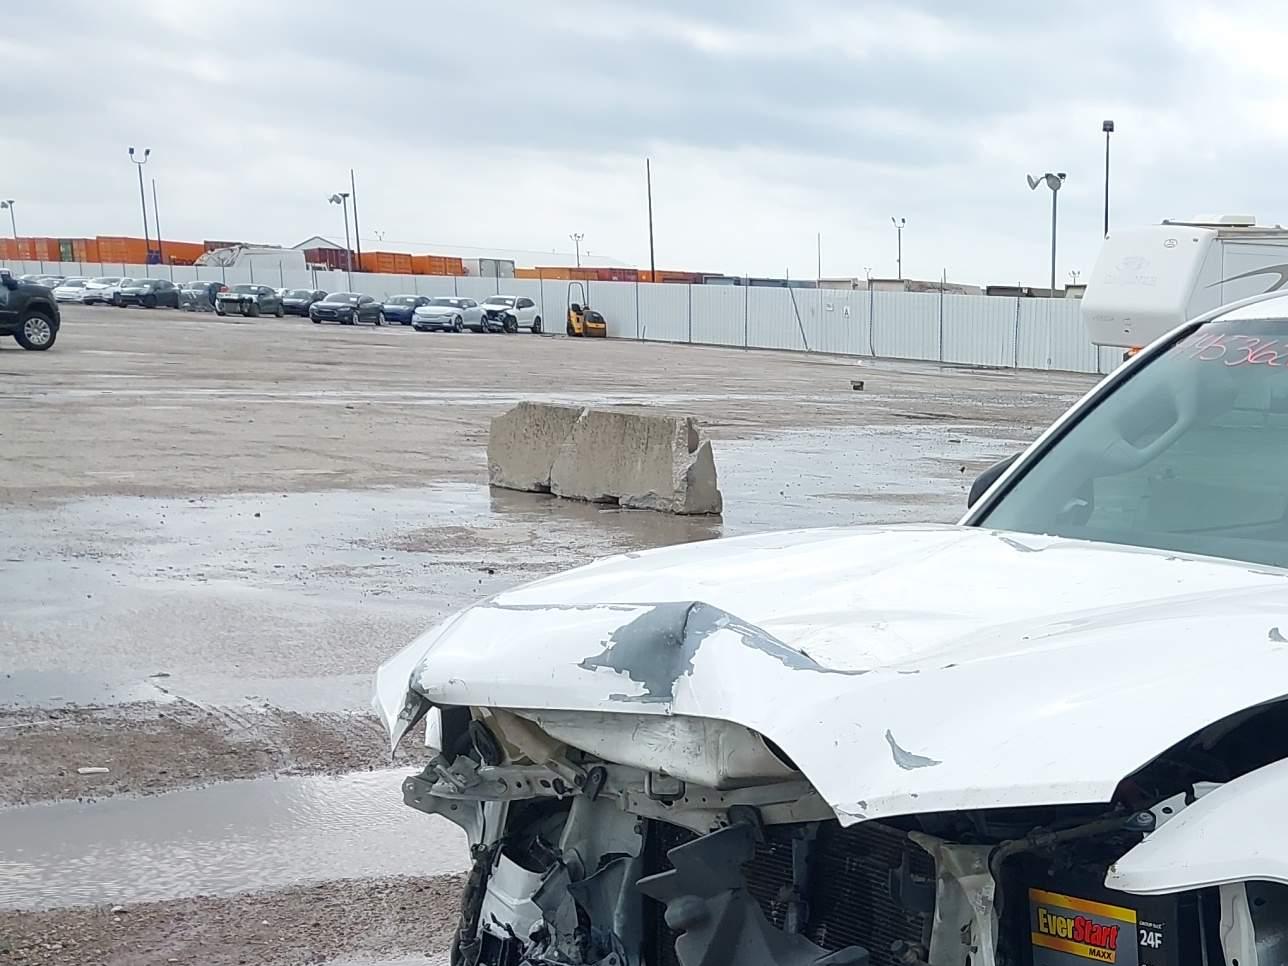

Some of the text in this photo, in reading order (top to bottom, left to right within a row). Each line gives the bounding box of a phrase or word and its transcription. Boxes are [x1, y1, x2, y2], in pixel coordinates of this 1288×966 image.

[1038, 907, 1120, 949] EverStart
[1140, 929, 1162, 949] 24F
[1088, 947, 1113, 960] MAXX
